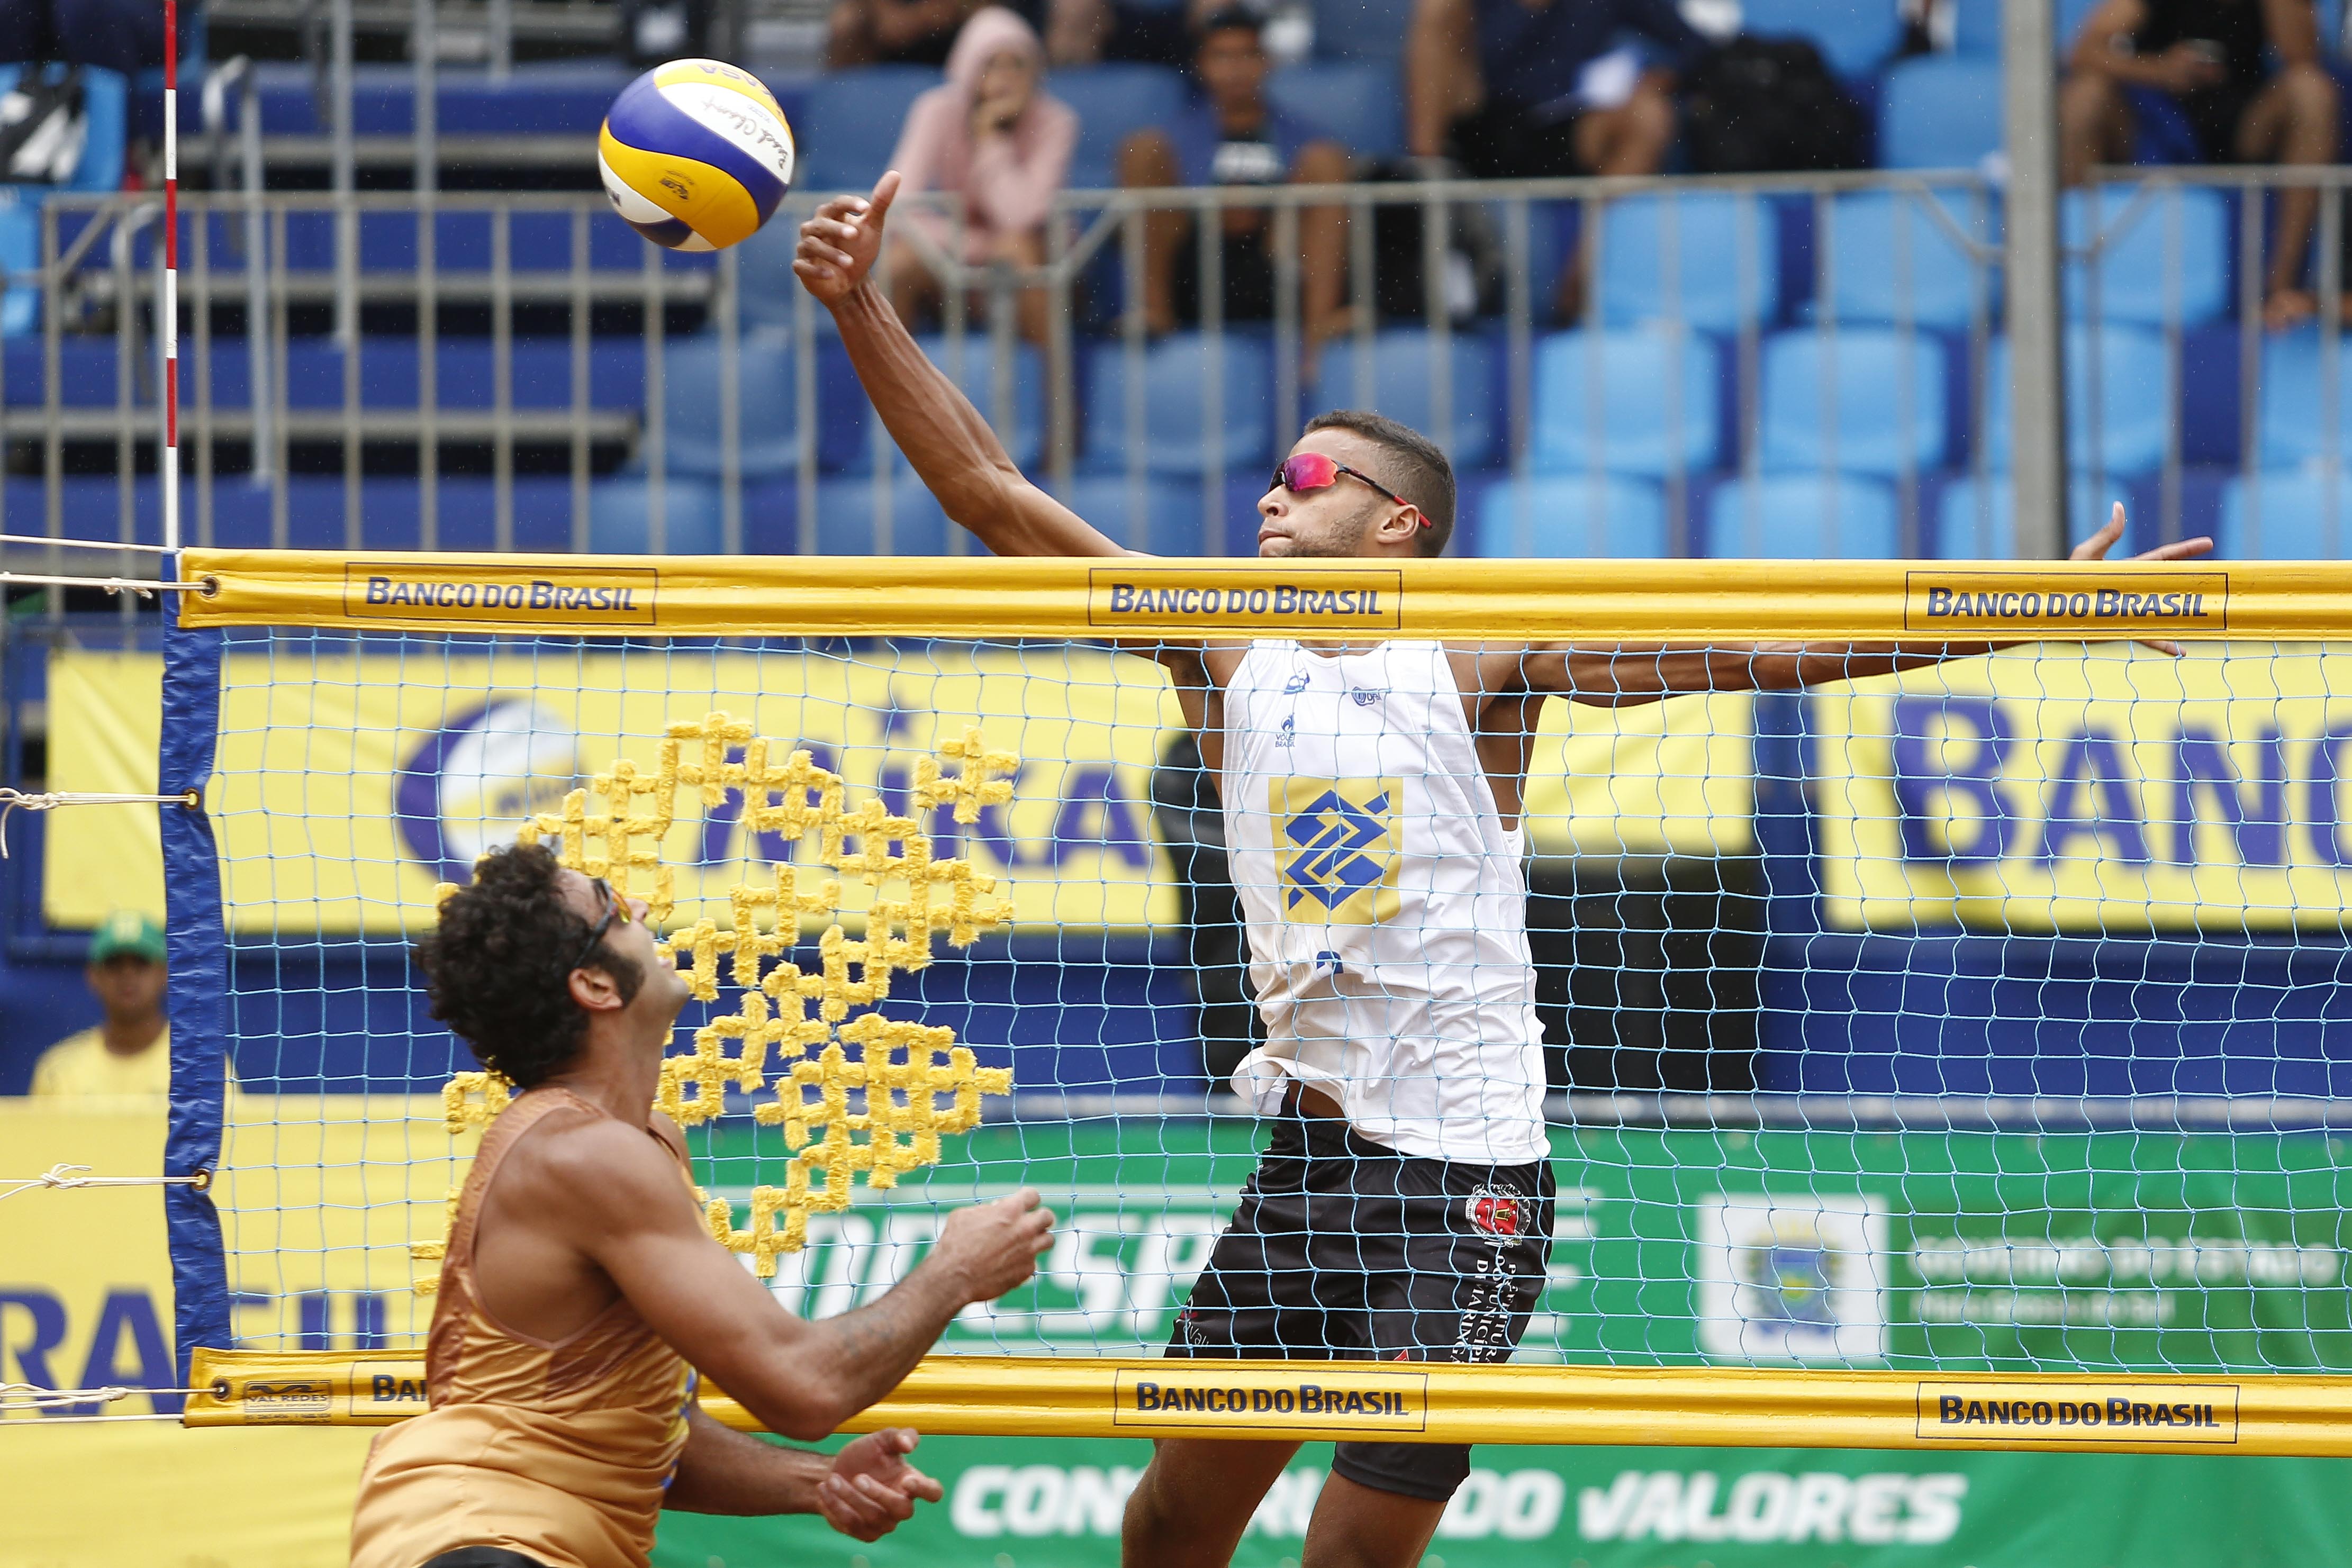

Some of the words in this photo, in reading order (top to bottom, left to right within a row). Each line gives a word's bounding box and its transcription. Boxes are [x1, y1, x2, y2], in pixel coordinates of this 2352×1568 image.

[366, 576, 476, 608] BANCO
[482, 584, 524, 609] DO
[529, 581, 638, 610] BRASIL
[1111, 584, 1221, 613] BANCO
[1227, 589, 1268, 614] DO
[1274, 585, 1383, 614] BRASIL
[1927, 587, 2040, 617] BANCO
[2047, 593, 2089, 618] DO
[2095, 588, 2208, 617] BRASIL
[1137, 1382, 1247, 1412] BANCO
[1254, 1389, 1293, 1413] DO
[1300, 1384, 1409, 1416] BRASIL
[1940, 1395, 2052, 1426] BANCO
[2059, 1402, 2102, 1426] DO
[2107, 1398, 2220, 1427] BRASIL
[1578, 1471, 1967, 1544] VALORES
